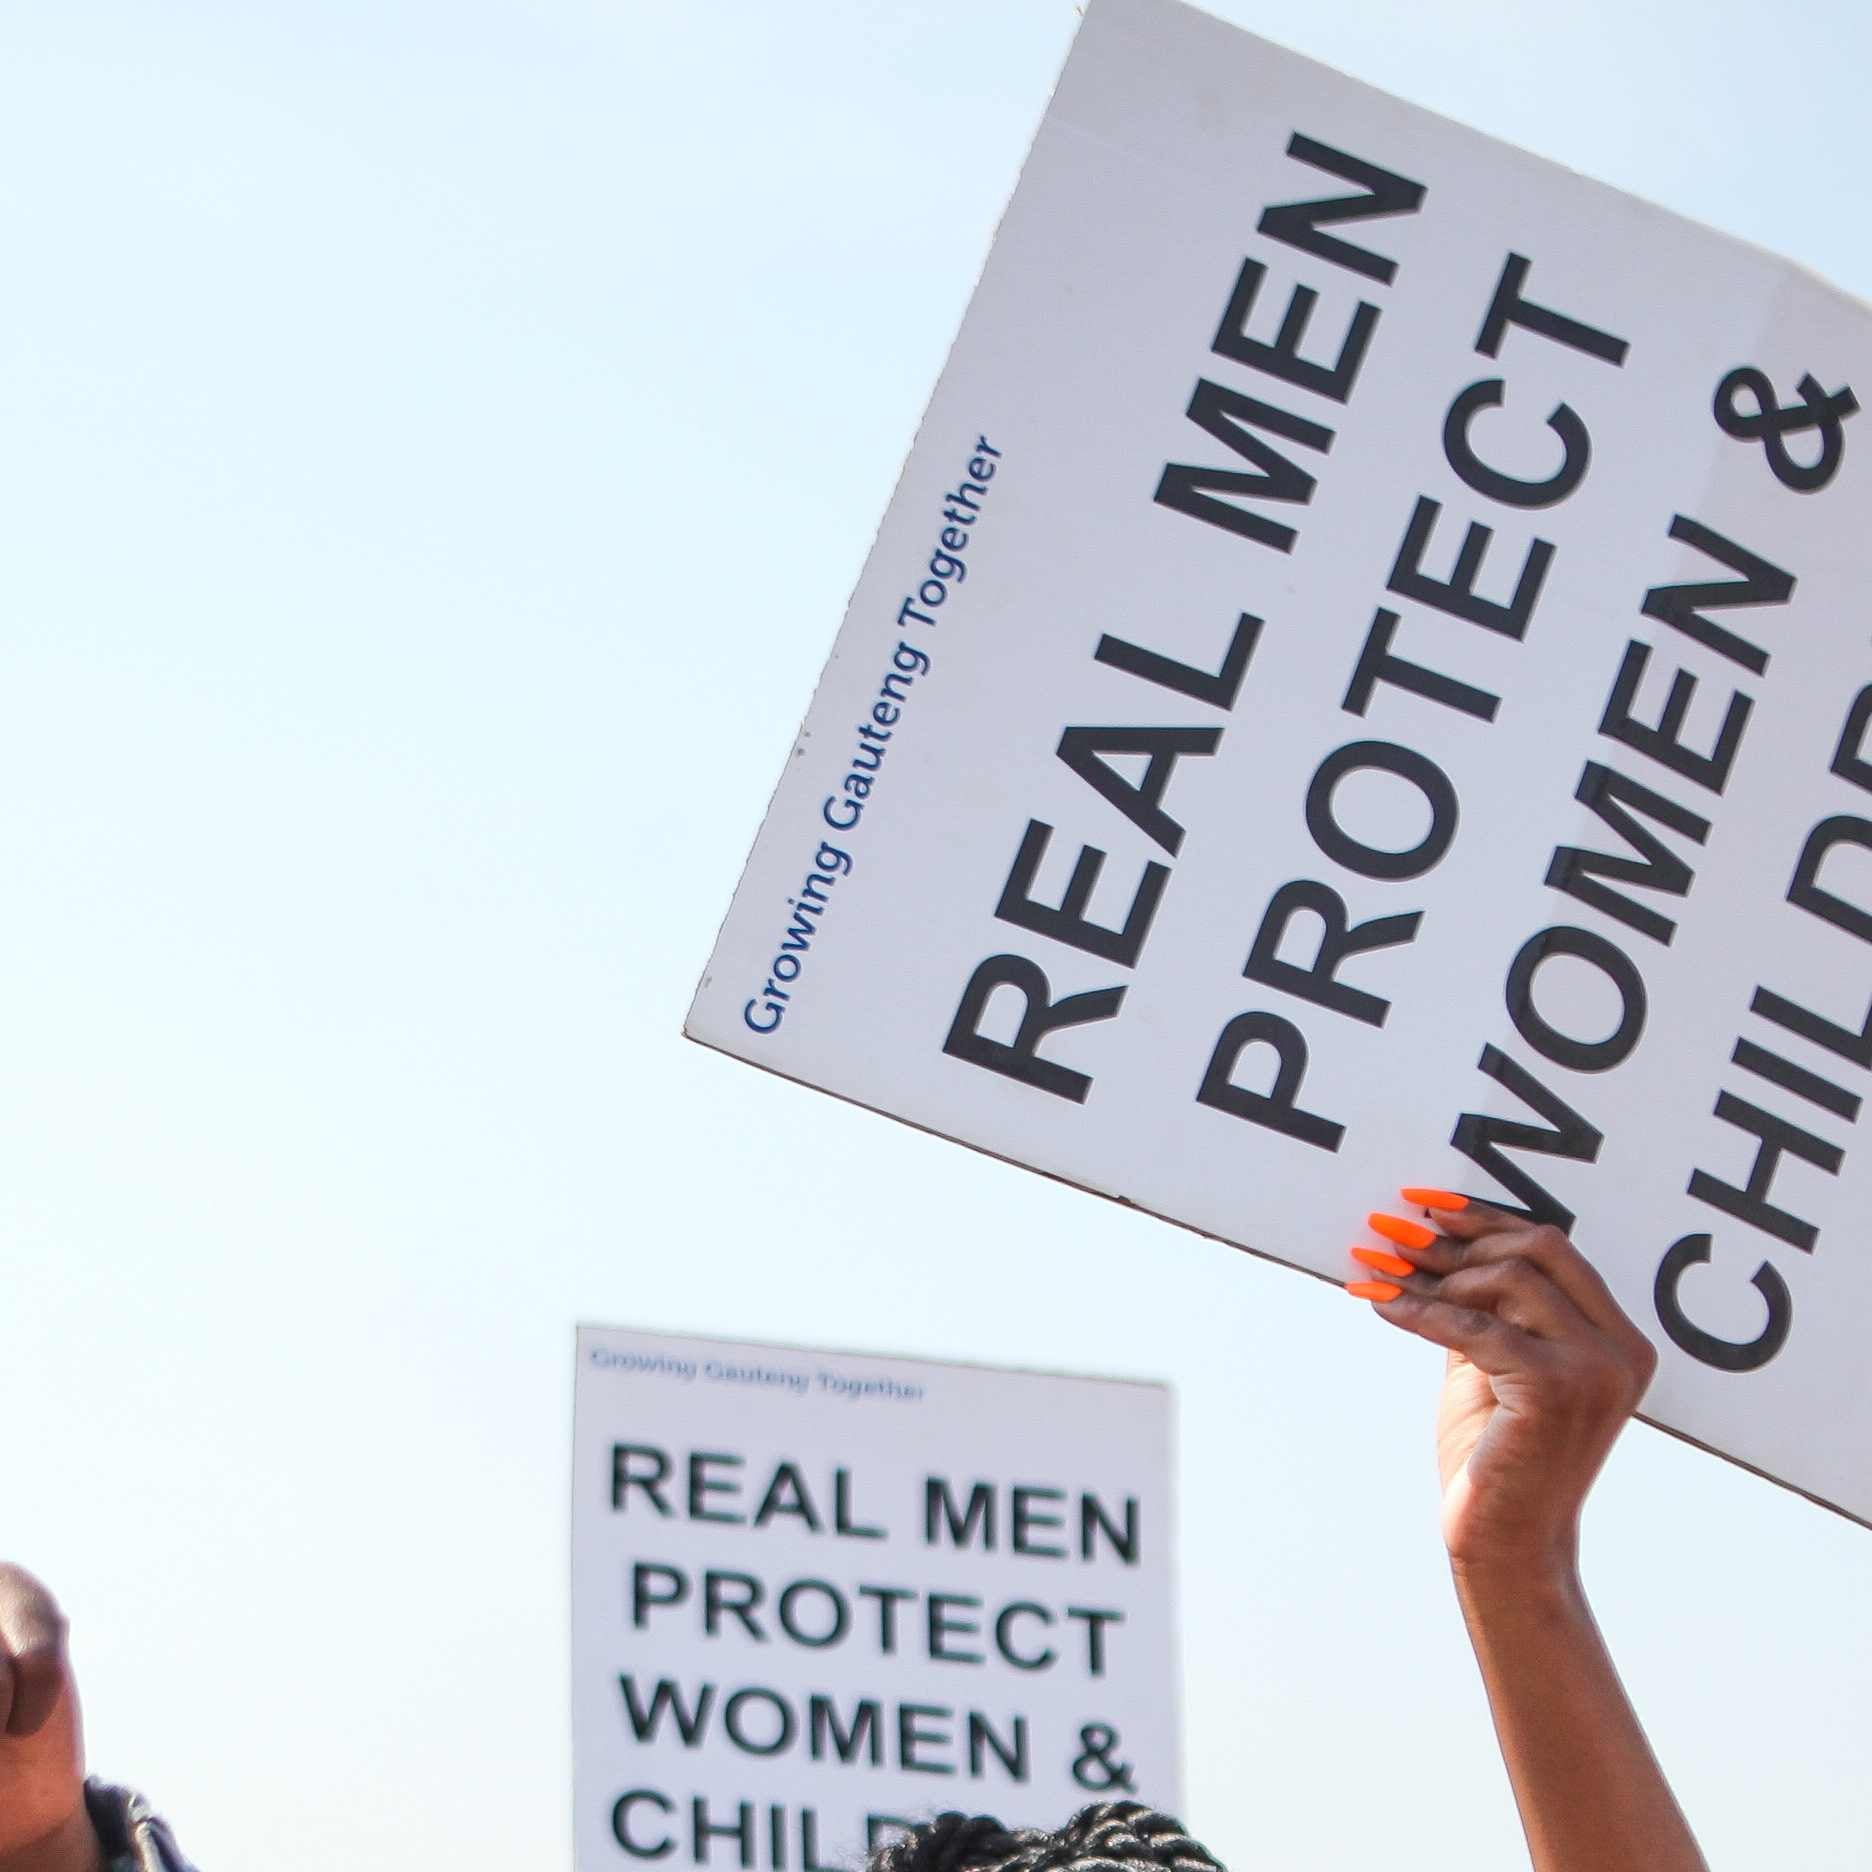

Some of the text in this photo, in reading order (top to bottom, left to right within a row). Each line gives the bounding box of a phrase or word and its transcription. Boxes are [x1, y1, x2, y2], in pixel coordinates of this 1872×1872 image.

[744, 434, 1003, 1036] Growing Gauteng Together
[942, 129, 1428, 1104] REAL MEN
[1195, 250, 1630, 1154] PROTECT
[1425, 364, 1862, 1237] WOMEN &
[590, 1347, 927, 1402] Growing Gauteng Together
[610, 1441, 1141, 1566] REAL MEN
[618, 1673, 1138, 1794] WOMEN &
[631, 1562, 1125, 1675] PROTECT
